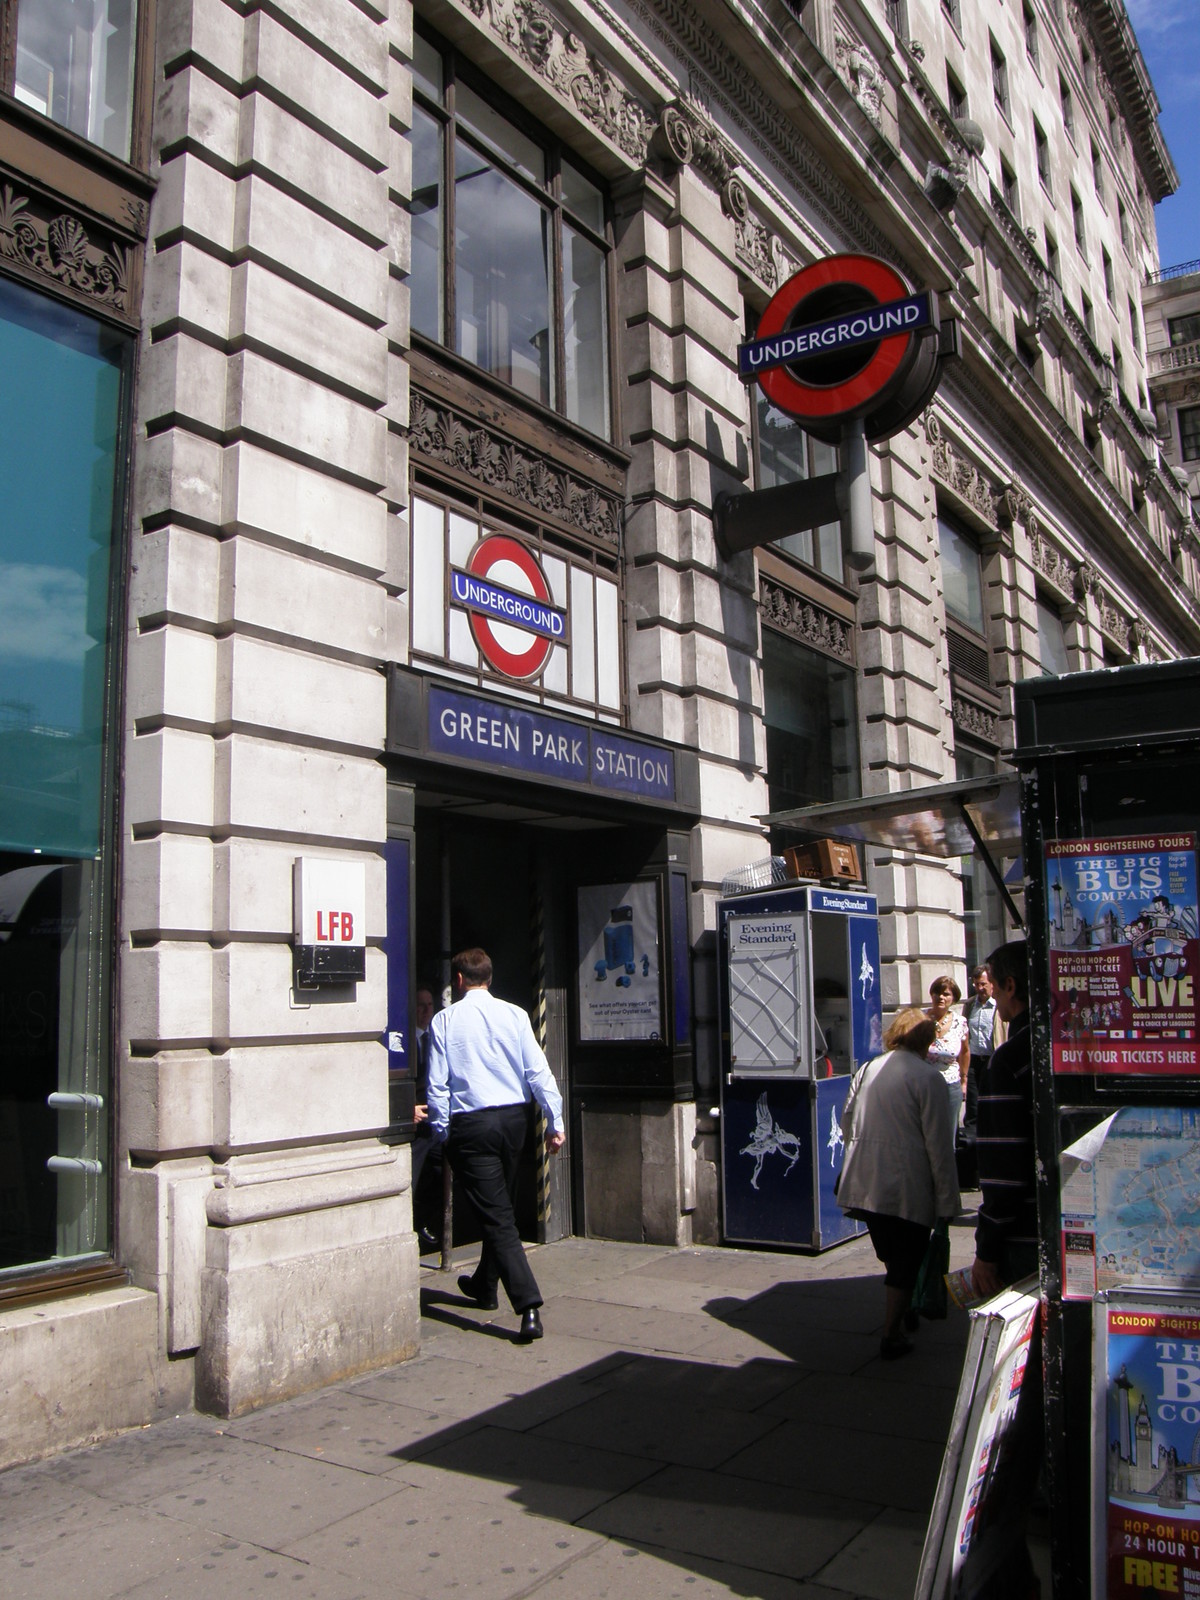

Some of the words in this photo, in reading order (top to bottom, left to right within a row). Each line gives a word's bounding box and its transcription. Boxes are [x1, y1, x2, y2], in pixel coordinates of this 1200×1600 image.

[749, 304, 920, 366] UNDERGROUND
[454, 574, 563, 636] UNDERGROUND
[440, 708, 520, 753] GREEN
[531, 729, 585, 767] PARK
[595, 746, 669, 787] STATION
[1050, 843, 1091, 855] LONDON
[1094, 839, 1156, 852] SIGHTSEEING
[1158, 837, 1191, 848] TOURS
[1075, 859, 1118, 871] THE
[1123, 856, 1162, 869] BIG
[1075, 867, 1163, 892] BUS
[1076, 889, 1163, 902] COMPANY
[316, 910, 354, 942] LFB
[741, 922, 792, 934] Evening
[739, 932, 797, 945] Standard
[1057, 957, 1086, 965] HOP-ON
[1088, 956, 1120, 964] HOP-OFF
[1058, 965, 1068, 973] 24
[1070, 965, 1092, 973] HOUR
[1095, 964, 1121, 972] TICKET
[1058, 976, 1088, 992] FREE
[1131, 975, 1194, 1007] LIVE
[1062, 1049, 1083, 1063] BUY
[1087, 1049, 1118, 1063] YOUR
[1121, 1050, 1164, 1064] TICKETS
[1167, 1050, 1196, 1064] HERE
[1111, 1315, 1156, 1328] LONDON
[1124, 1519, 1175, 1539] HOP-ON
[1181, 1527, 1200, 1543] HO
[1124, 1534, 1140, 1550] 24
[1147, 1538, 1186, 1557] HOUR
[1124, 1556, 1179, 1593] FREE
